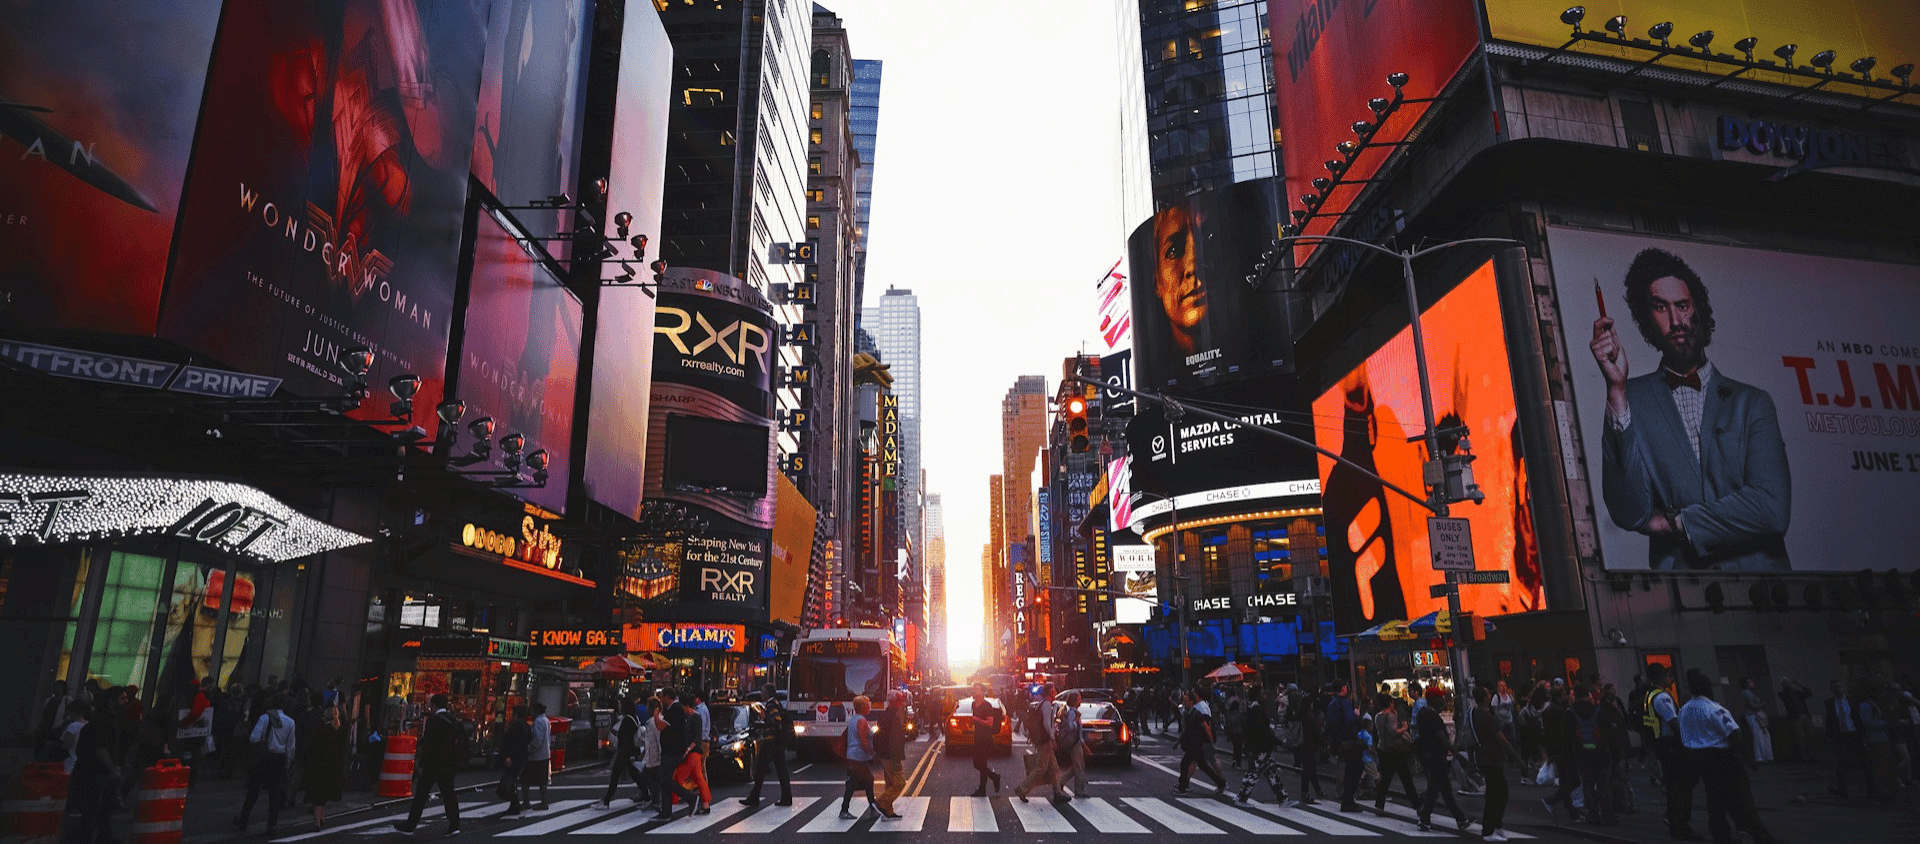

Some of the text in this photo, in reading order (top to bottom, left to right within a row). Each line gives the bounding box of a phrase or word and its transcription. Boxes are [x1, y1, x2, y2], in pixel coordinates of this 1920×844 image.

[1717, 115, 1808, 160] DOW
[240, 182, 432, 330] WONDER WOMAN
[246, 271, 264, 288] THE
[268, 283, 300, 309] FUTURE
[304, 304, 316, 316] OF
[319, 313, 349, 336] JUSTICE
[352, 332, 378, 352] BEGINS
[381, 348, 397, 363] WITH
[302, 330, 339, 365] JUN
[654, 306, 768, 375] RXR
[1817, 341, 1835, 353] AN
[1841, 342, 1873, 355] HBO
[681, 358, 745, 378] rxrrealty.com
[788, 245, 812, 472] CHAMPS
[184, 370, 270, 398] PRIME
[470, 352, 525, 403] WONDER
[1782, 355, 1920, 411] T.J. M
[650, 394, 695, 403] SHARP
[884, 395, 898, 476] MADAME
[1180, 423, 1221, 439] MAZDA
[1181, 433, 1234, 453] SERVICES
[1851, 450, 1903, 473] JUNE
[1206, 489, 1239, 502] CHASE
[170, 497, 287, 552] LOFT
[1436, 522, 1462, 532] BUSES
[728, 538, 747, 551] New
[748, 541, 761, 553] York
[1440, 533, 1460, 543] ONLY
[686, 549, 763, 570] for the 21st Century
[1095, 529, 1106, 574] VICTORY
[1119, 553, 1154, 562] WORK
[700, 567, 755, 595] RXR
[1468, 571, 1508, 584] Broadway
[711, 591, 747, 602] REALTY
[1014, 573, 1026, 635] REGAL
[1194, 593, 1297, 611] CHASE CHASE
[543, 630, 582, 646] KNOW
[658, 628, 736, 647] CHAMPS
[1415, 651, 1440, 666] SODA
